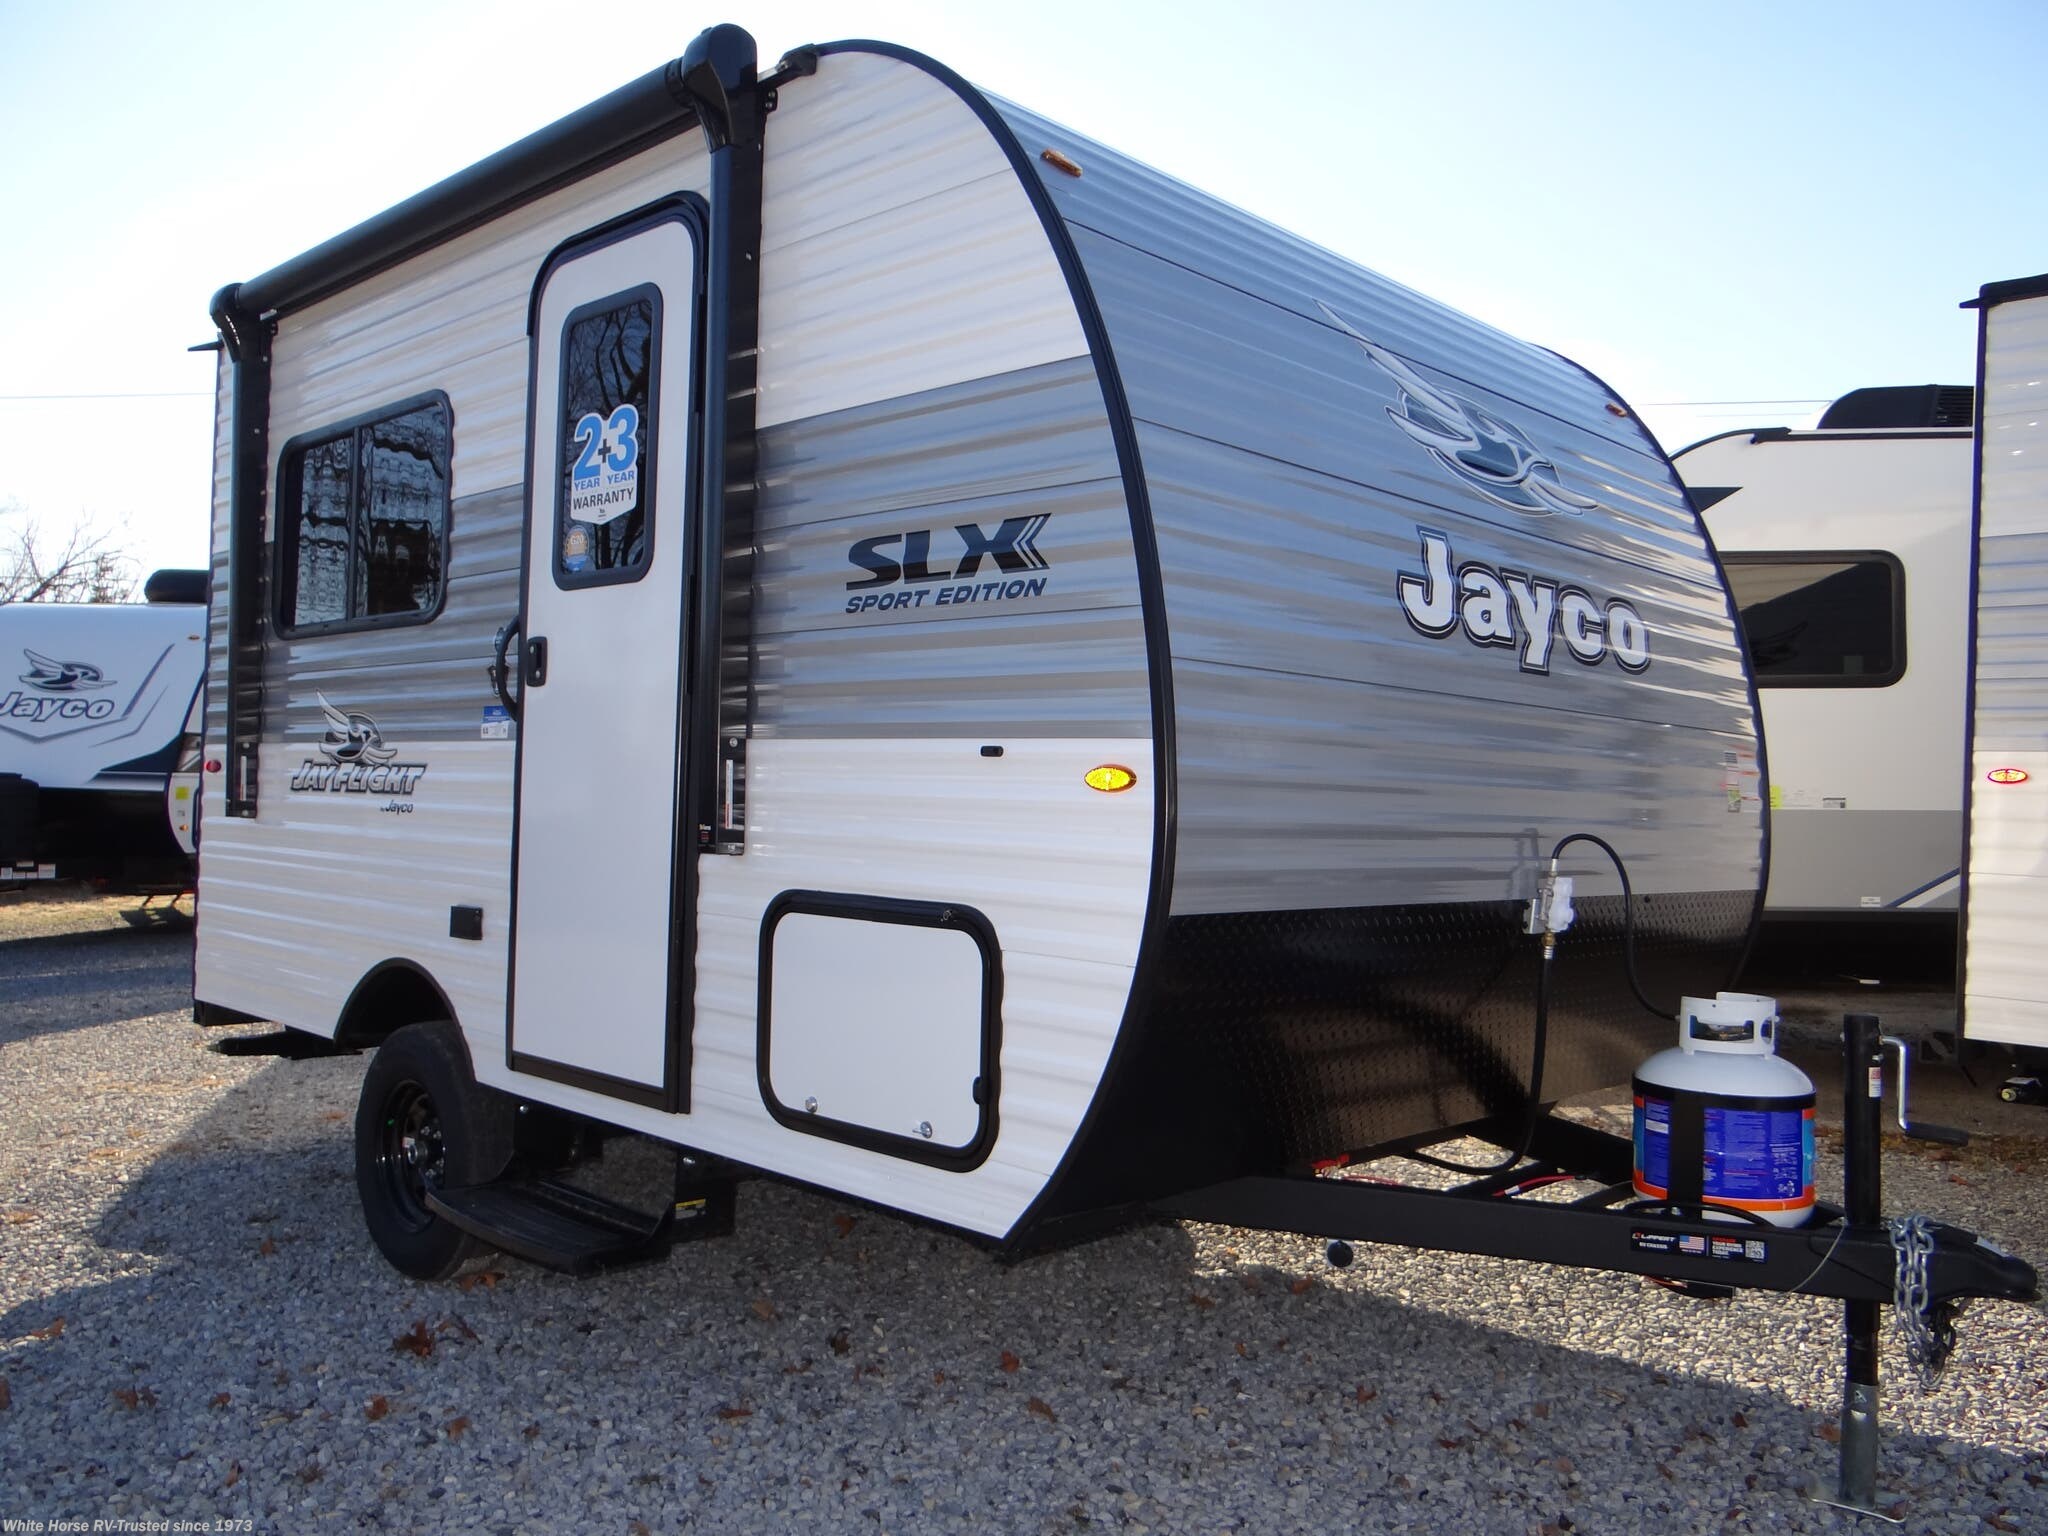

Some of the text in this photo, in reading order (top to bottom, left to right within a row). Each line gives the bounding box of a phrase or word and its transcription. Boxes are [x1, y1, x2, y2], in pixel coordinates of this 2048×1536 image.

[574, 470, 635, 492] YEAR YEAR
[573, 487, 634, 510] WARRANTY
[846, 513, 1052, 591] SLX
[845, 577, 1048, 614] SPORT EDITION
[1397, 525, 1651, 677] Jayco
[385, 800, 414, 815] Jayco
